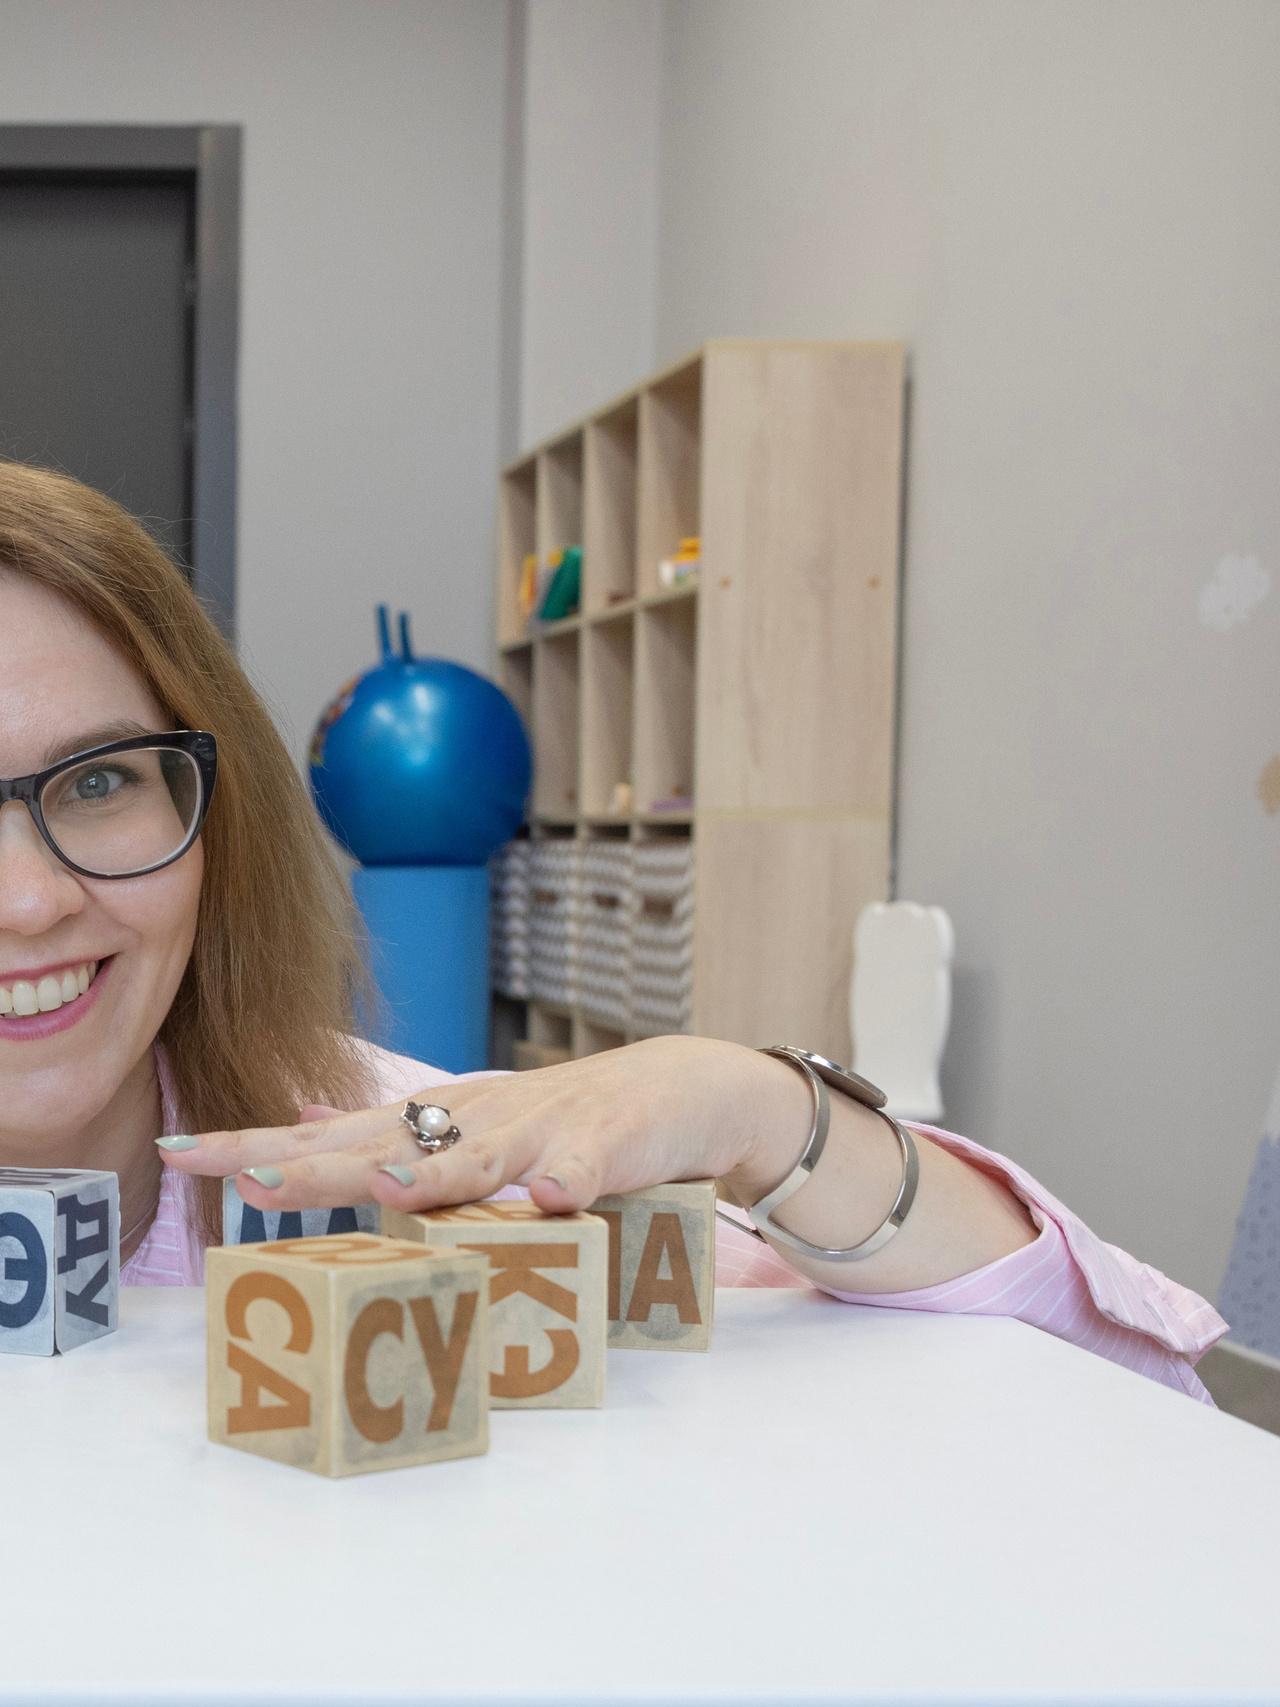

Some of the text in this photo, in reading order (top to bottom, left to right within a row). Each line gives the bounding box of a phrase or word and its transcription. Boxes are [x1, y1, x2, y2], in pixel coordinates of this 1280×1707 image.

[57, 1193, 108, 1327] ДУ
[456, 1243, 580, 1398] КЭ
[587, 1210, 702, 1324] А
[225, 1271, 313, 1435] СА
[344, 1291, 480, 1444] СУ
